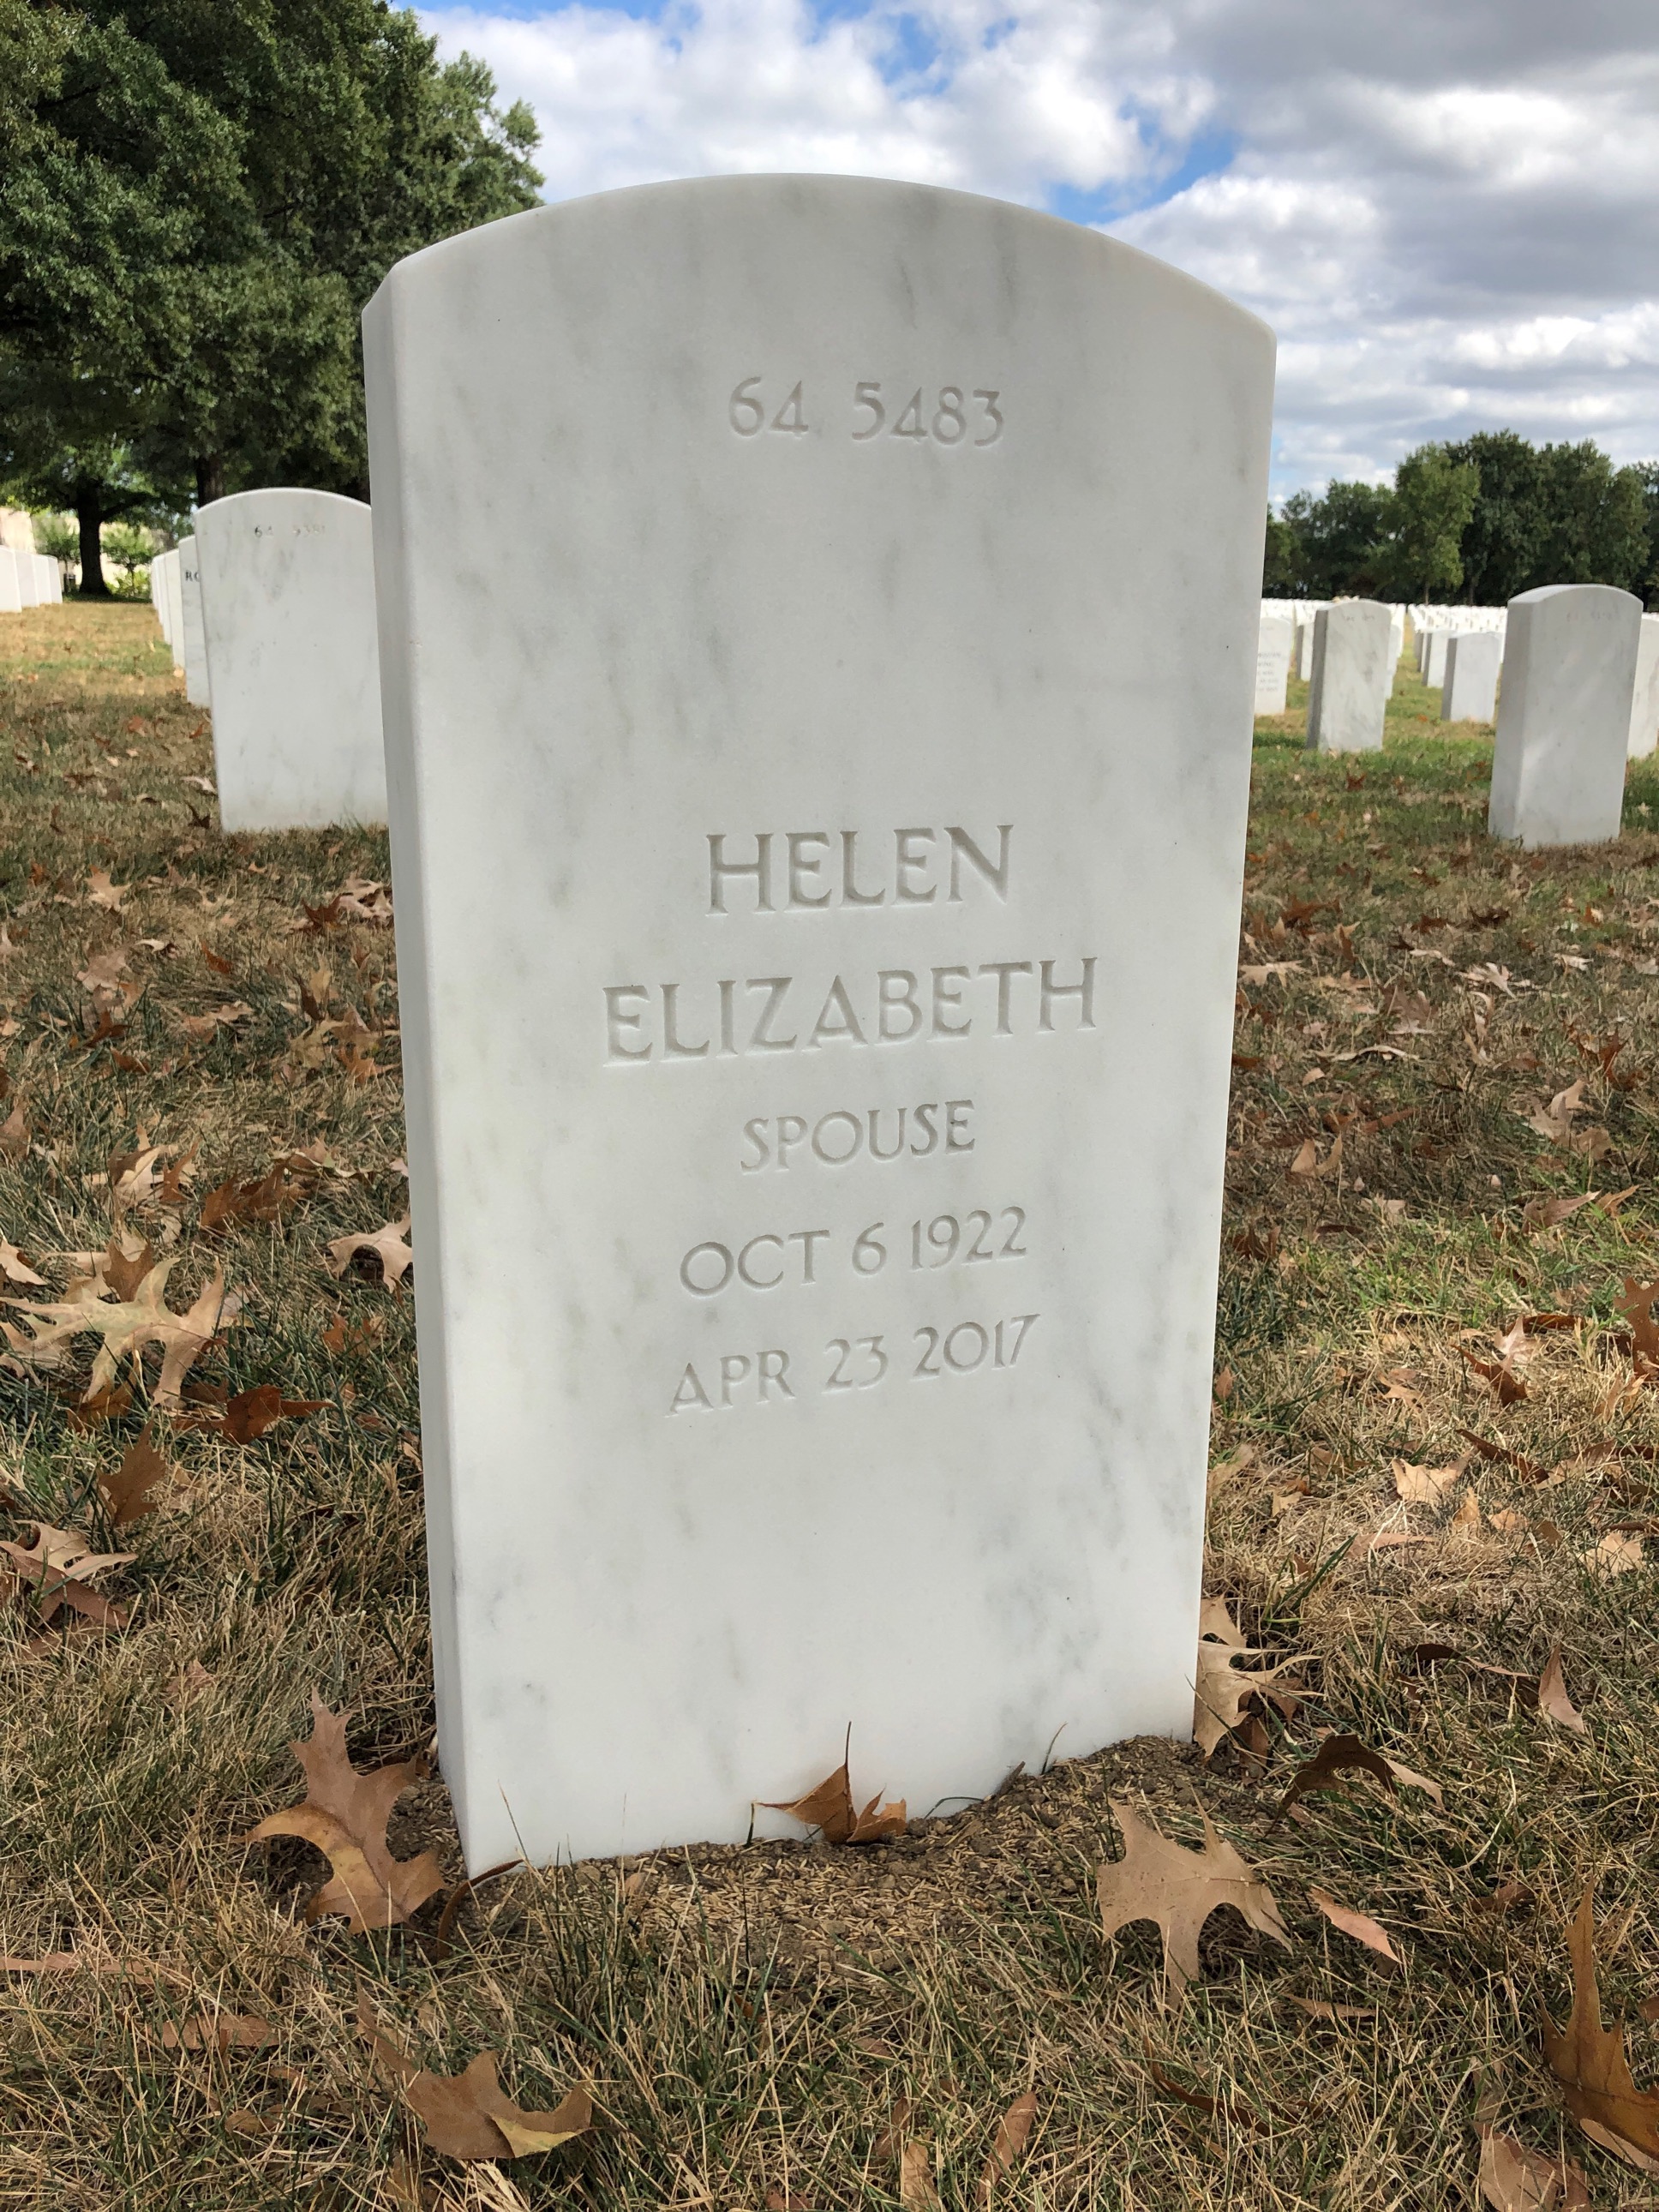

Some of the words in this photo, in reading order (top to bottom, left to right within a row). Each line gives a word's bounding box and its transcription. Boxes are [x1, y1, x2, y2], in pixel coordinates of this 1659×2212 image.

[728, 376, 809, 437] 64
[852, 381, 1004, 447] 5483
[705, 824, 1014, 916] HELEN
[602, 957, 1098, 1067] ELIZABETH
[740, 1100, 975, 1175] SPOUSE
[680, 1229, 830, 1298] OCT
[852, 1222, 888, 1277] 6
[910, 1206, 1027, 1272] 1922
[664, 1349, 796, 1418] APR
[822, 1335, 889, 1394] 23
[910, 1313, 1040, 1381] 2017
